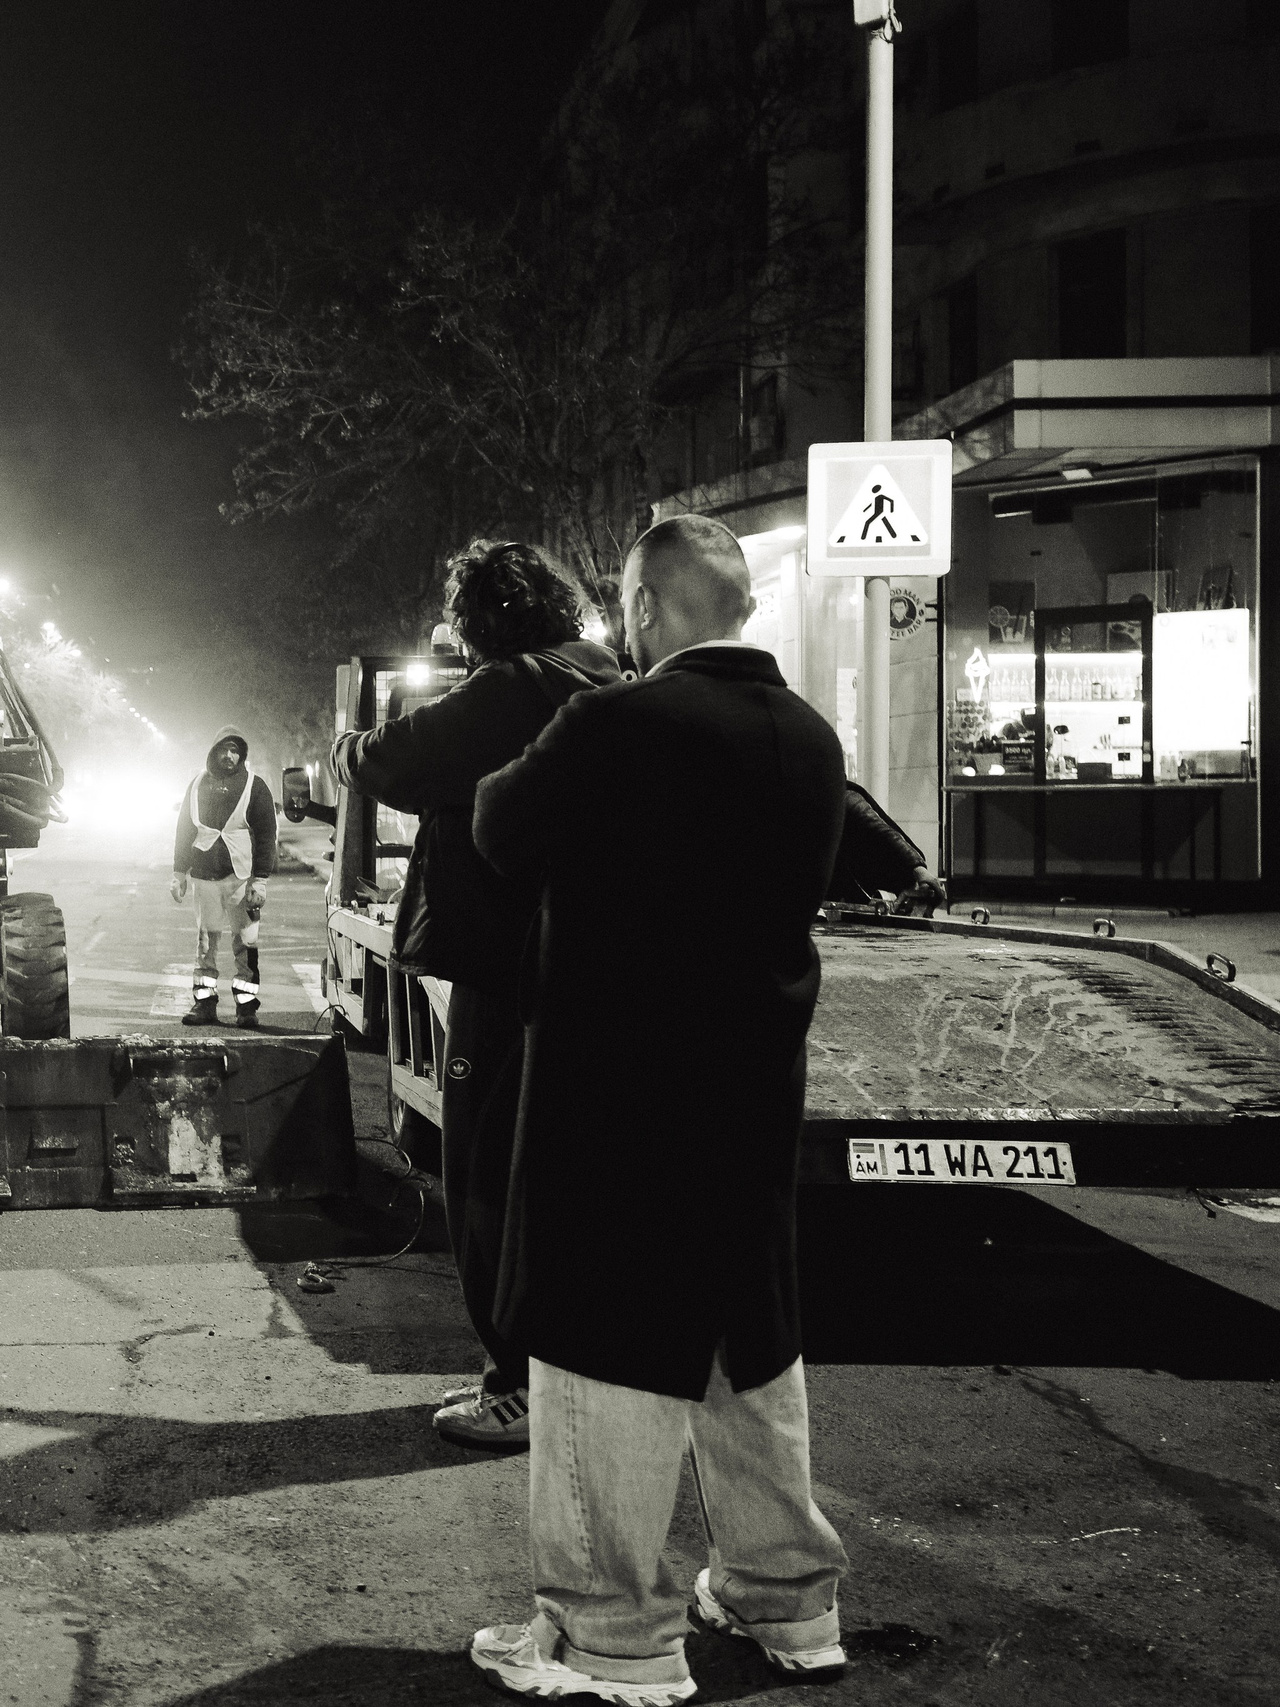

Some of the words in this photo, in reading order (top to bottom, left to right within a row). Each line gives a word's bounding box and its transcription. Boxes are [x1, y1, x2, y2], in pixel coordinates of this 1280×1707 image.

[856, 1161, 879, 1175] AM
[894, 1143, 935, 1176] 11
[943, 1143, 994, 1178] WA
[1002, 1146, 1065, 1179] 211
